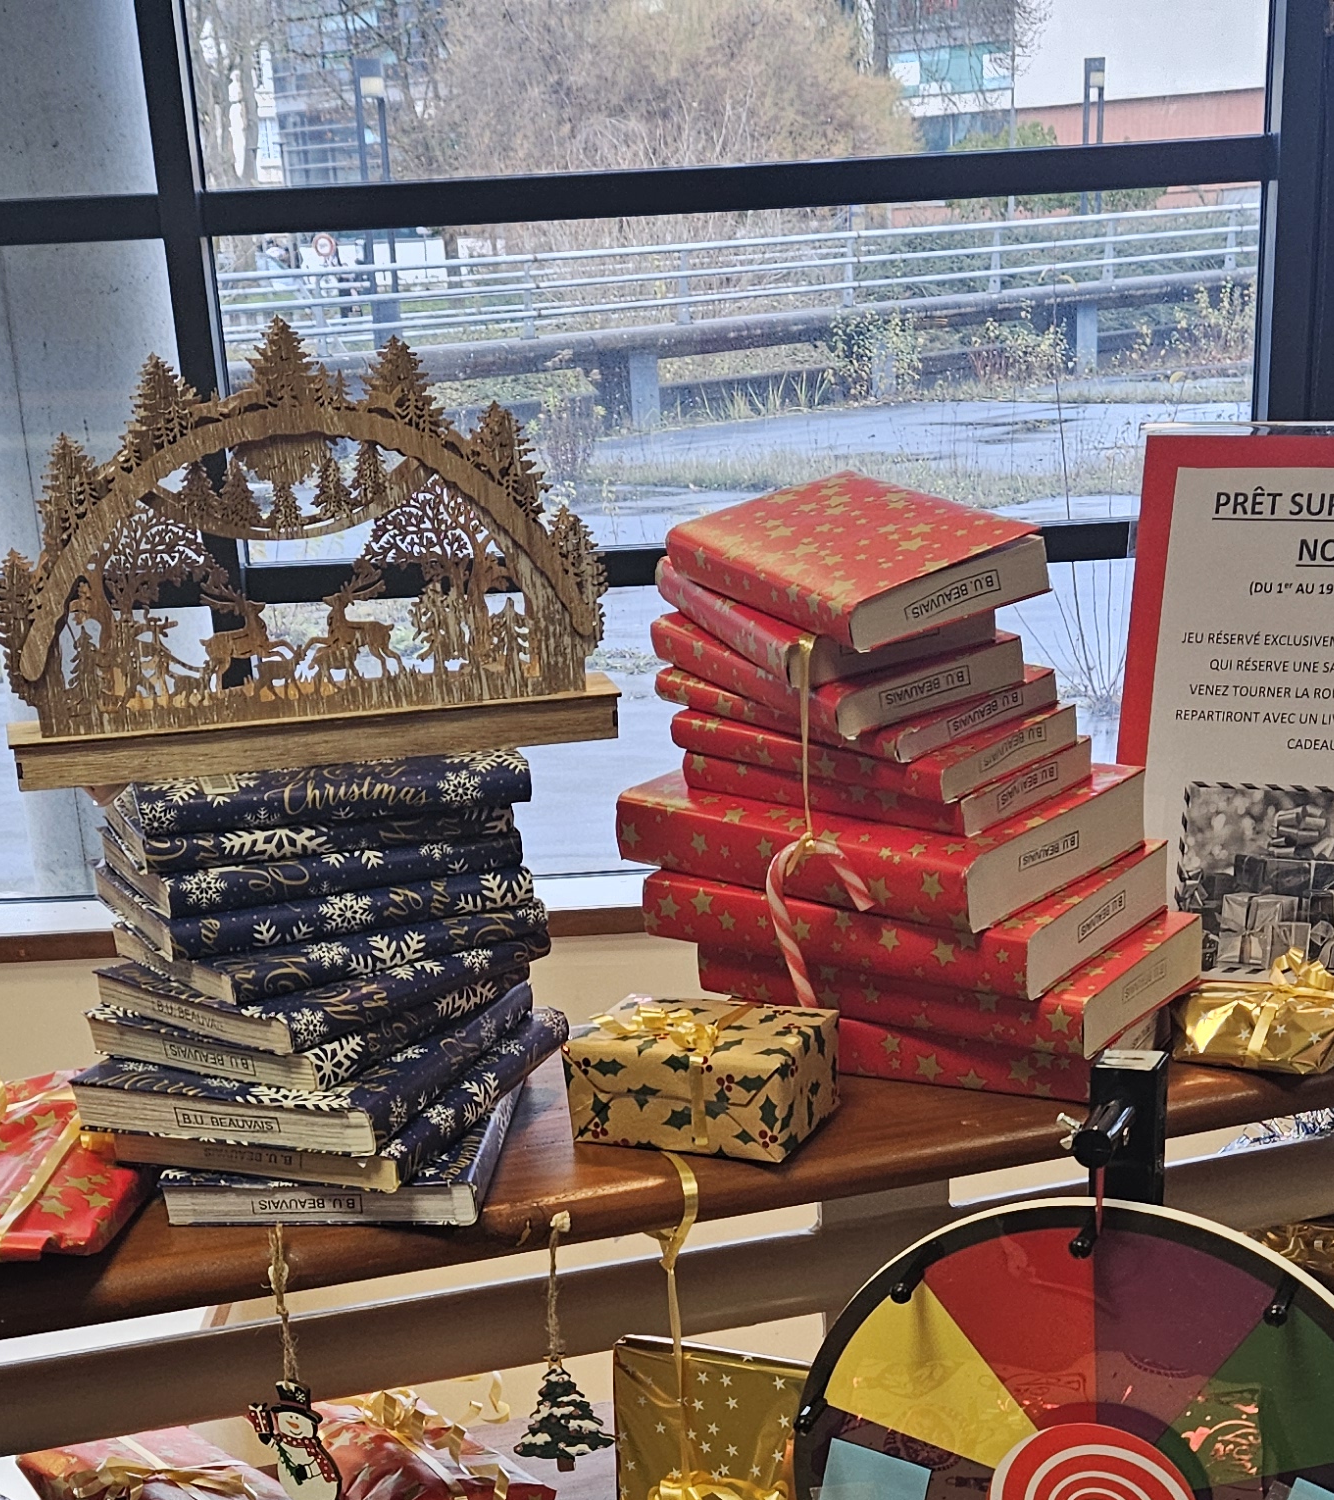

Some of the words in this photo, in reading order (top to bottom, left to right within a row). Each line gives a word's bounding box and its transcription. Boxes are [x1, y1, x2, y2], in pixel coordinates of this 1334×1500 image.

[1214, 485, 1284, 517] PRÊT
[970, 575, 994, 592] B.U.
[1249, 580, 1274, 596] (DU
[1294, 582, 1315, 595] AU
[1317, 582, 1334, 595] 19
[911, 583, 968, 619] BEAUVAIS
[1181, 631, 1204, 644] JEU
[1207, 629, 1261, 646] RÉSERVÉ
[1209, 658, 1233, 672] QUI
[1236, 656, 1290, 673] RÉSERVE
[1292, 660, 1320, 674] UNE
[942, 670, 965, 686] B.U.
[885, 677, 940, 705] BEAUVAIS
[1188, 683, 1230, 697] VENEZ
[1231, 684, 1292, 699] TOURNER
[1294, 686, 1310, 699] LA
[951, 698, 997, 732] BEAUVAIS
[1175, 709, 1261, 724] REPARTIRONT
[1262, 711, 1297, 725] AVEC
[1298, 712, 1319, 725] UN
[264, 775, 433, 815] Christmas
[169, 1043, 224, 1066] BEAUVAIS
[182, 1112, 208, 1126] B.U.
[210, 1116, 274, 1131] BEAUVAIS
[258, 1198, 324, 1210] BEAUVAIS
